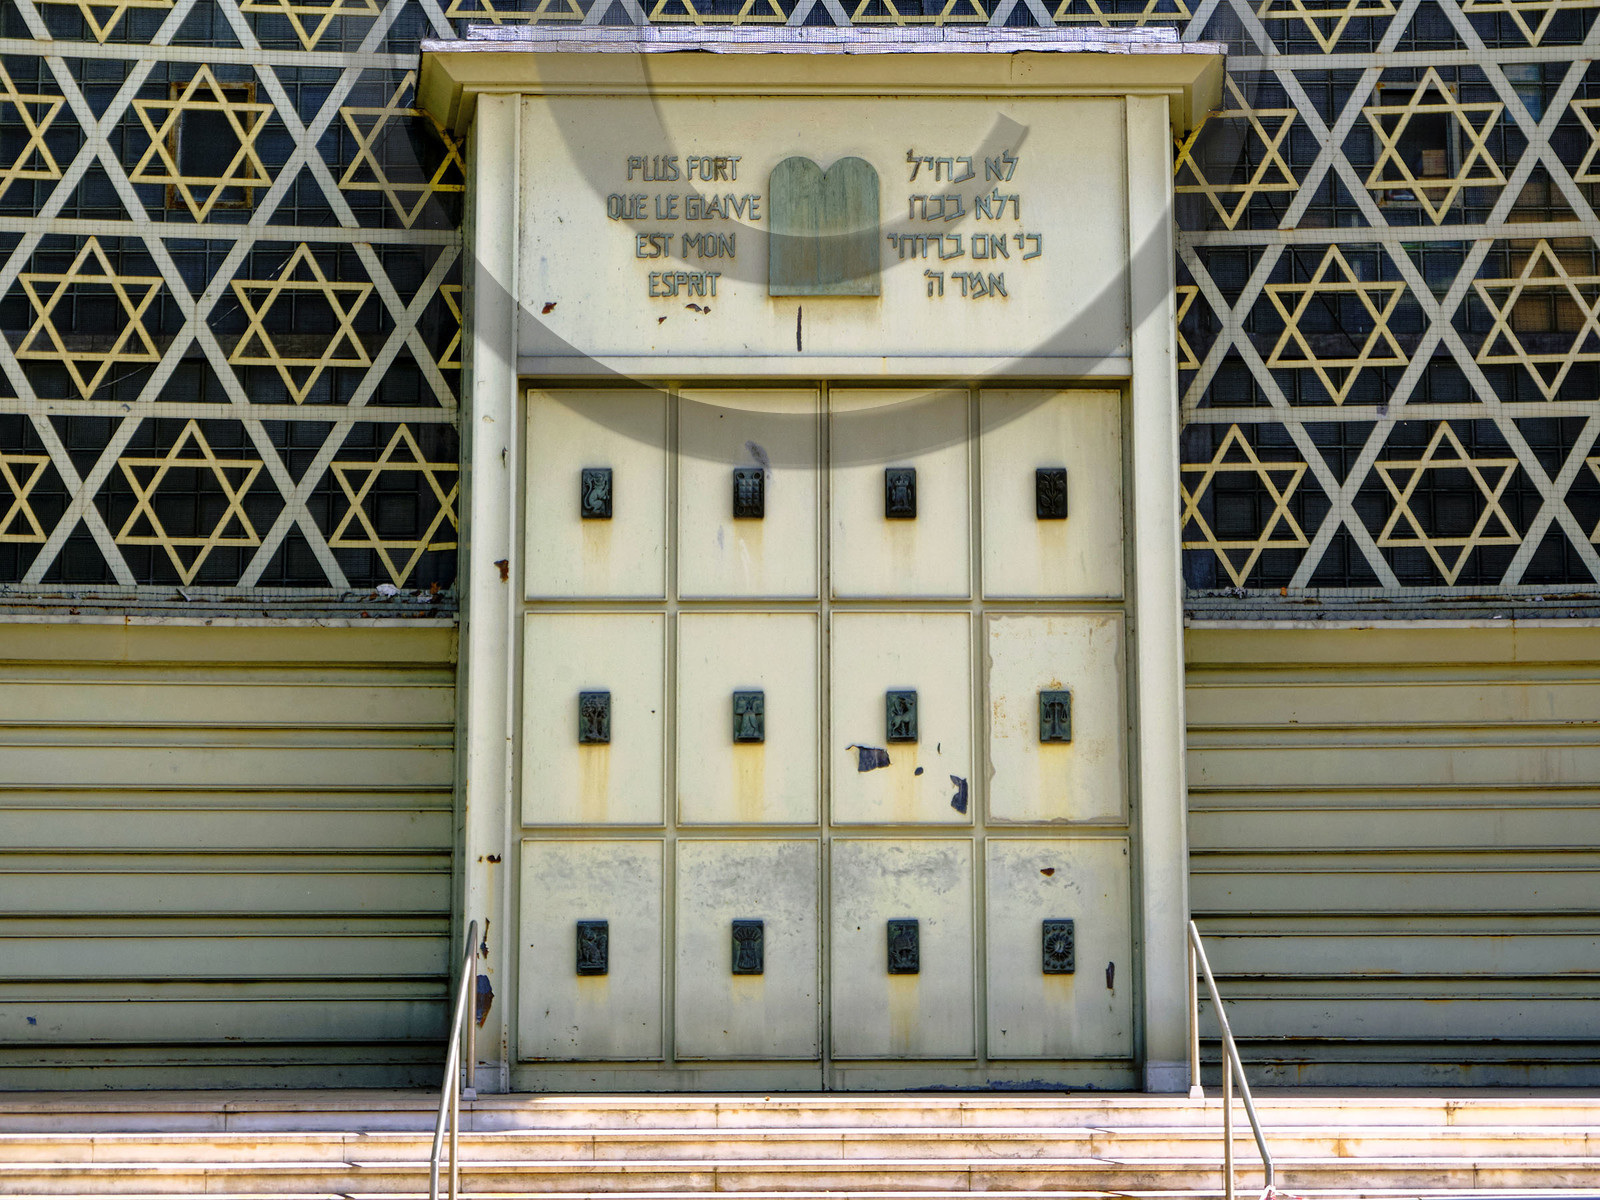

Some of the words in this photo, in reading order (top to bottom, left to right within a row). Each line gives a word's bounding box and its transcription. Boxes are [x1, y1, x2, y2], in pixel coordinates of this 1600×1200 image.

[627, 155, 680, 182] PLUS
[686, 155, 743, 182] FORT
[906, 148, 976, 184] בחיל
[984, 148, 1019, 182] לא
[607, 193, 648, 221] QUE
[655, 193, 680, 220] LE
[685, 193, 762, 220] GLAIVE
[908, 194, 966, 222] בכח
[975, 187, 1020, 221] ולא
[635, 232, 675, 259] EST
[681, 232, 736, 259] MON
[886, 232, 966, 261] ברוחי
[970, 232, 1010, 260] אם
[1012, 232, 1043, 261] כי
[648, 270, 722, 298] ESPRIT
